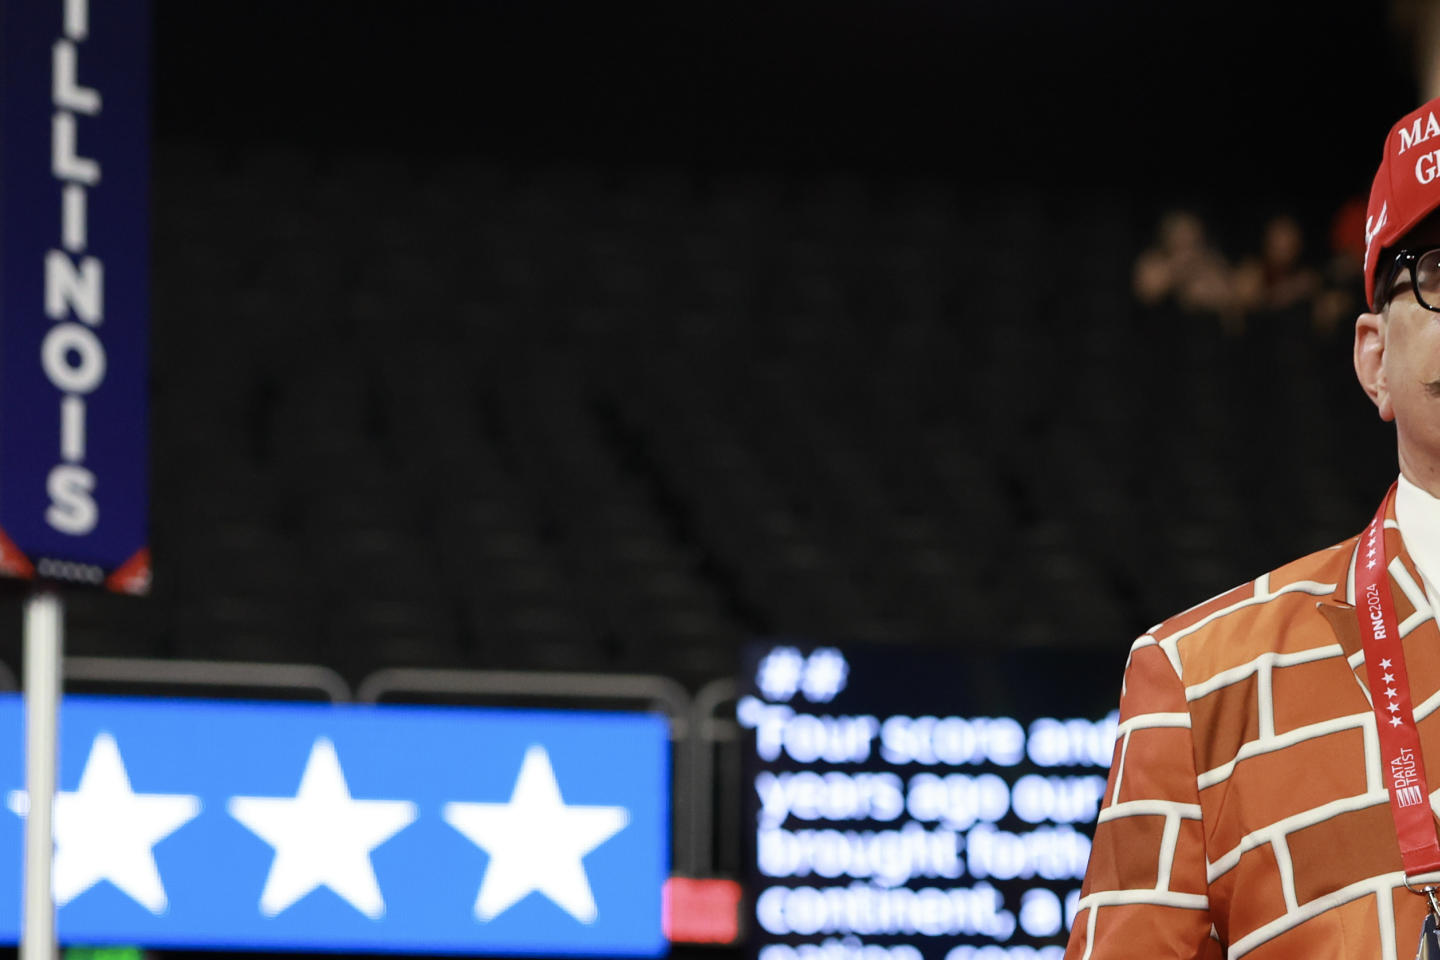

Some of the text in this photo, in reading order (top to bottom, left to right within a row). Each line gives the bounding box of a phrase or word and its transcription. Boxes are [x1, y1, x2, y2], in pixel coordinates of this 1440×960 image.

[1366, 583, 1387, 641] RNC2024
[1391, 756, 1407, 789] DATA
[1400, 747, 1418, 786] TRUST
